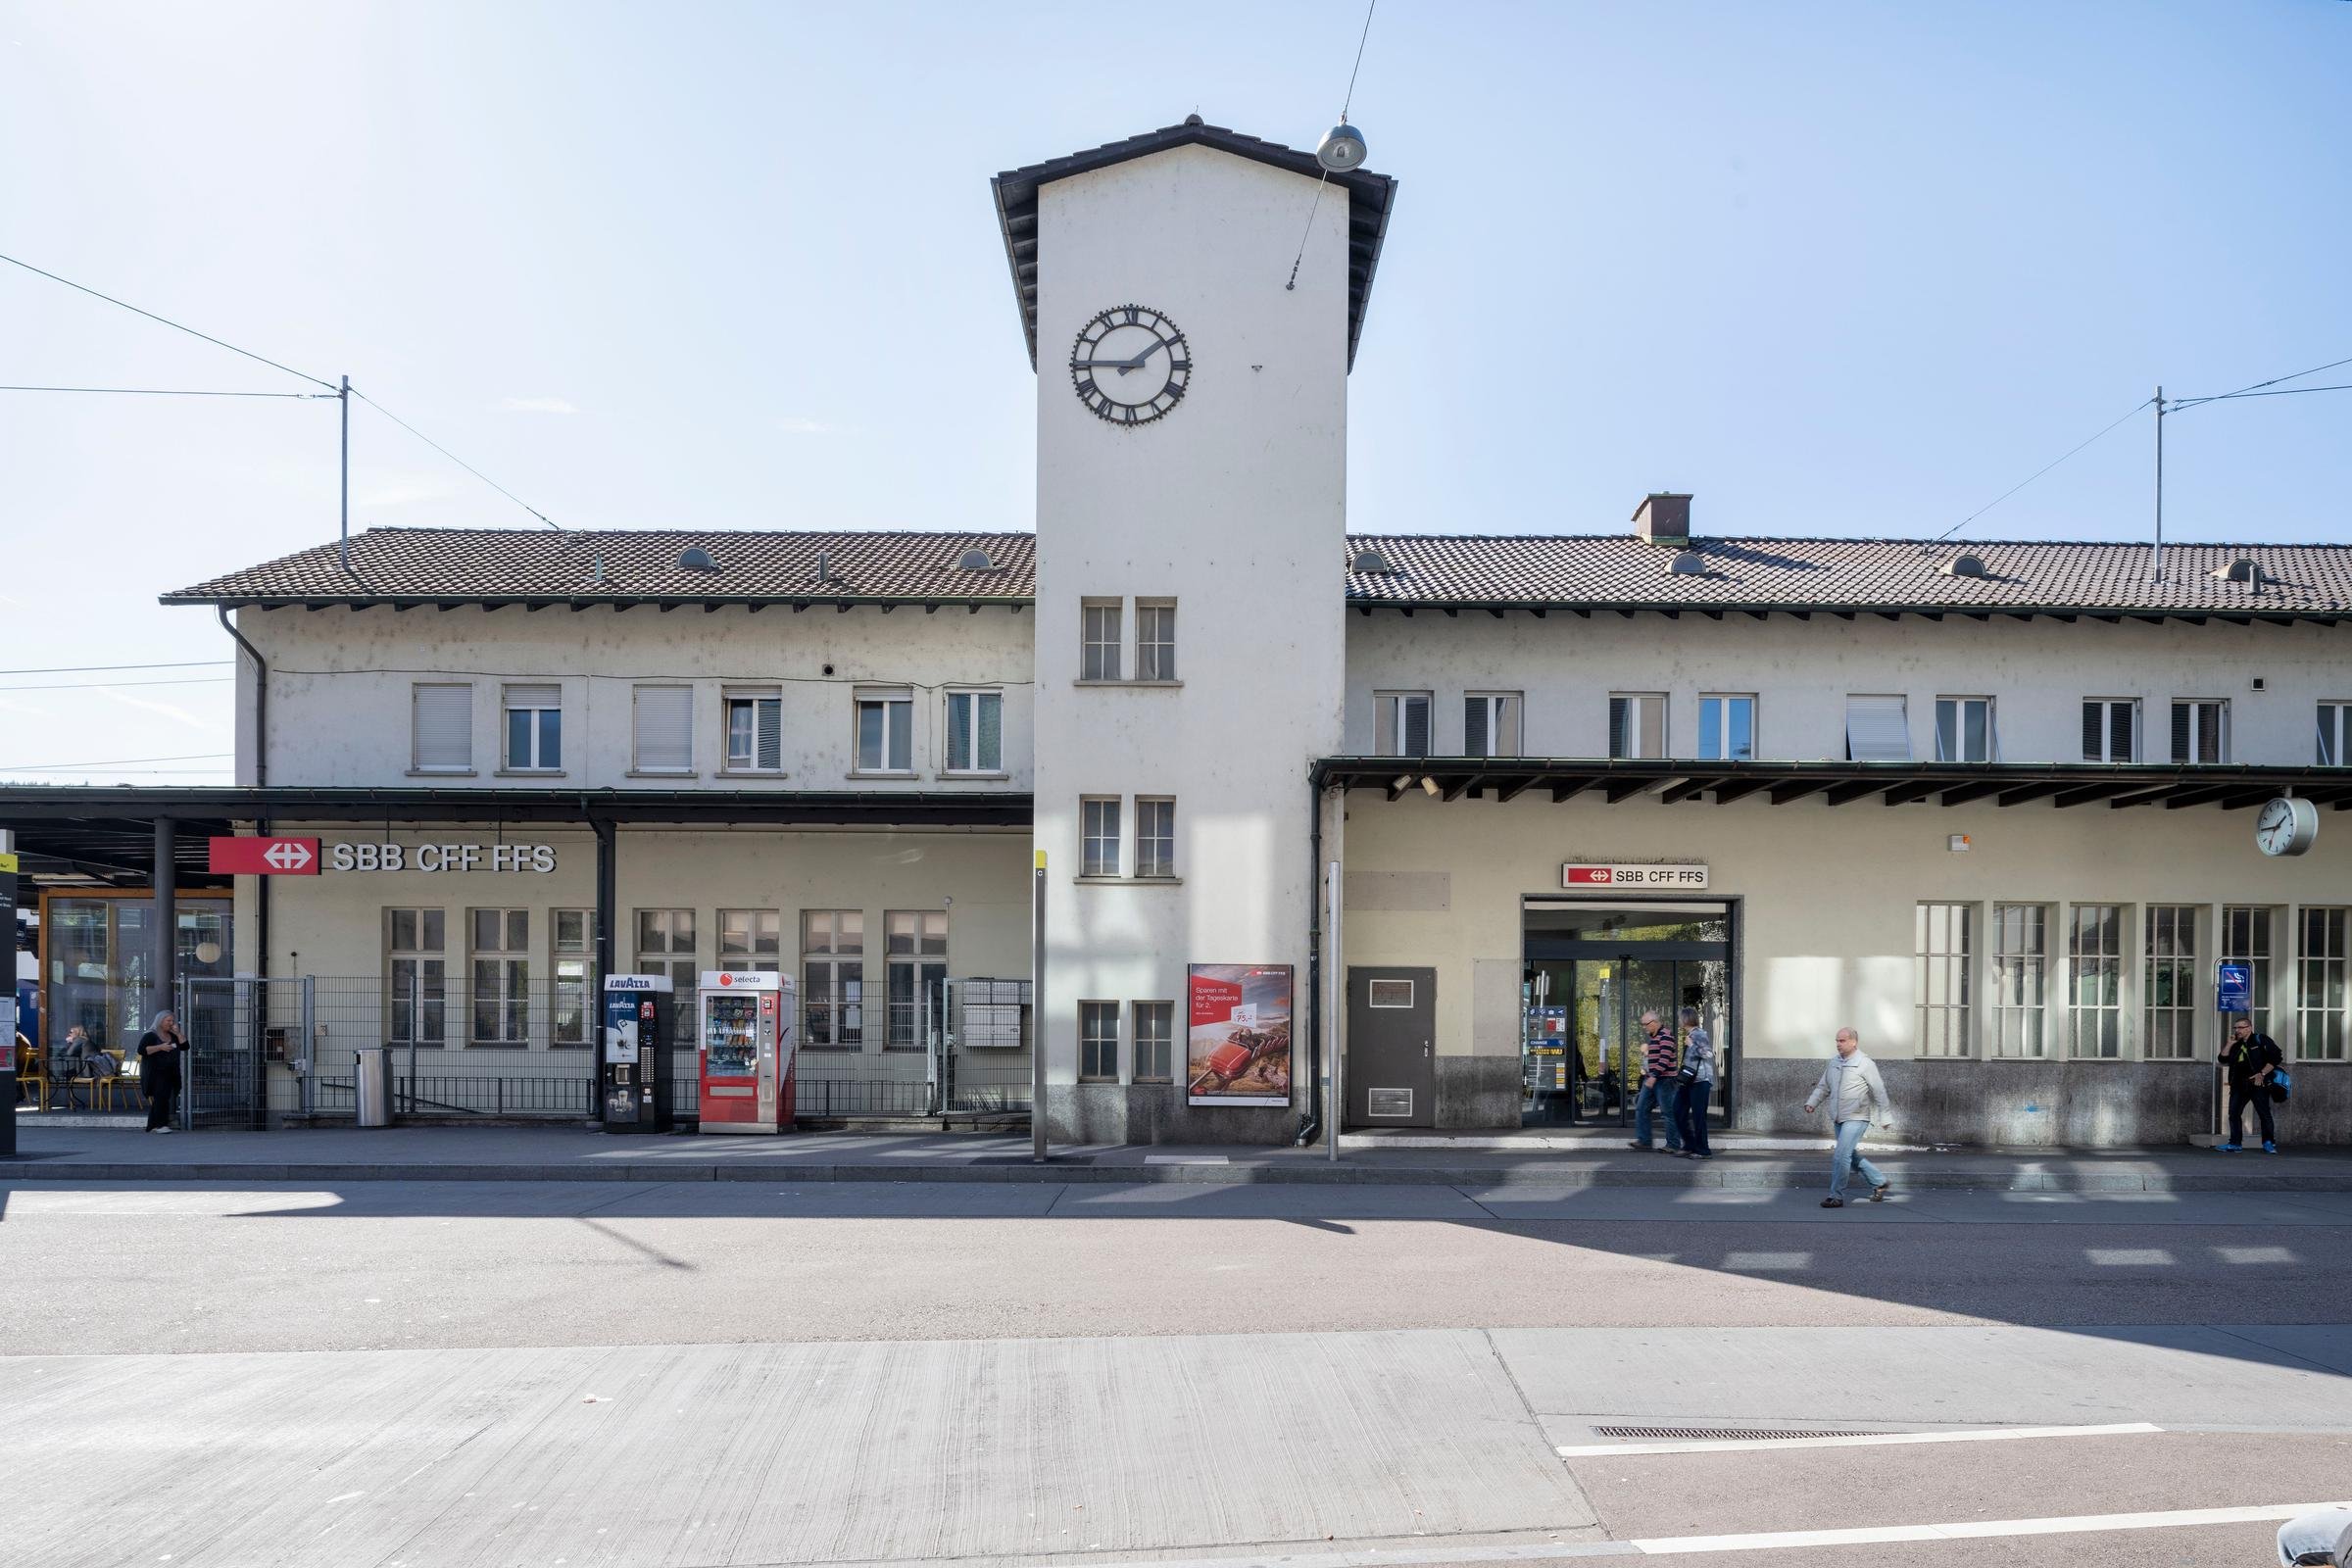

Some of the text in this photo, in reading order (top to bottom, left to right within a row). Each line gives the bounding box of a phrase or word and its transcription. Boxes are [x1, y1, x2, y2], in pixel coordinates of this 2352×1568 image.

[332, 843, 558, 874] SBB CFF FFS
[1616, 871, 1704, 882] SBB CFF FFS
[610, 977, 651, 989] LAVAZZA
[609, 1001, 636, 1009] LAVAZZA
